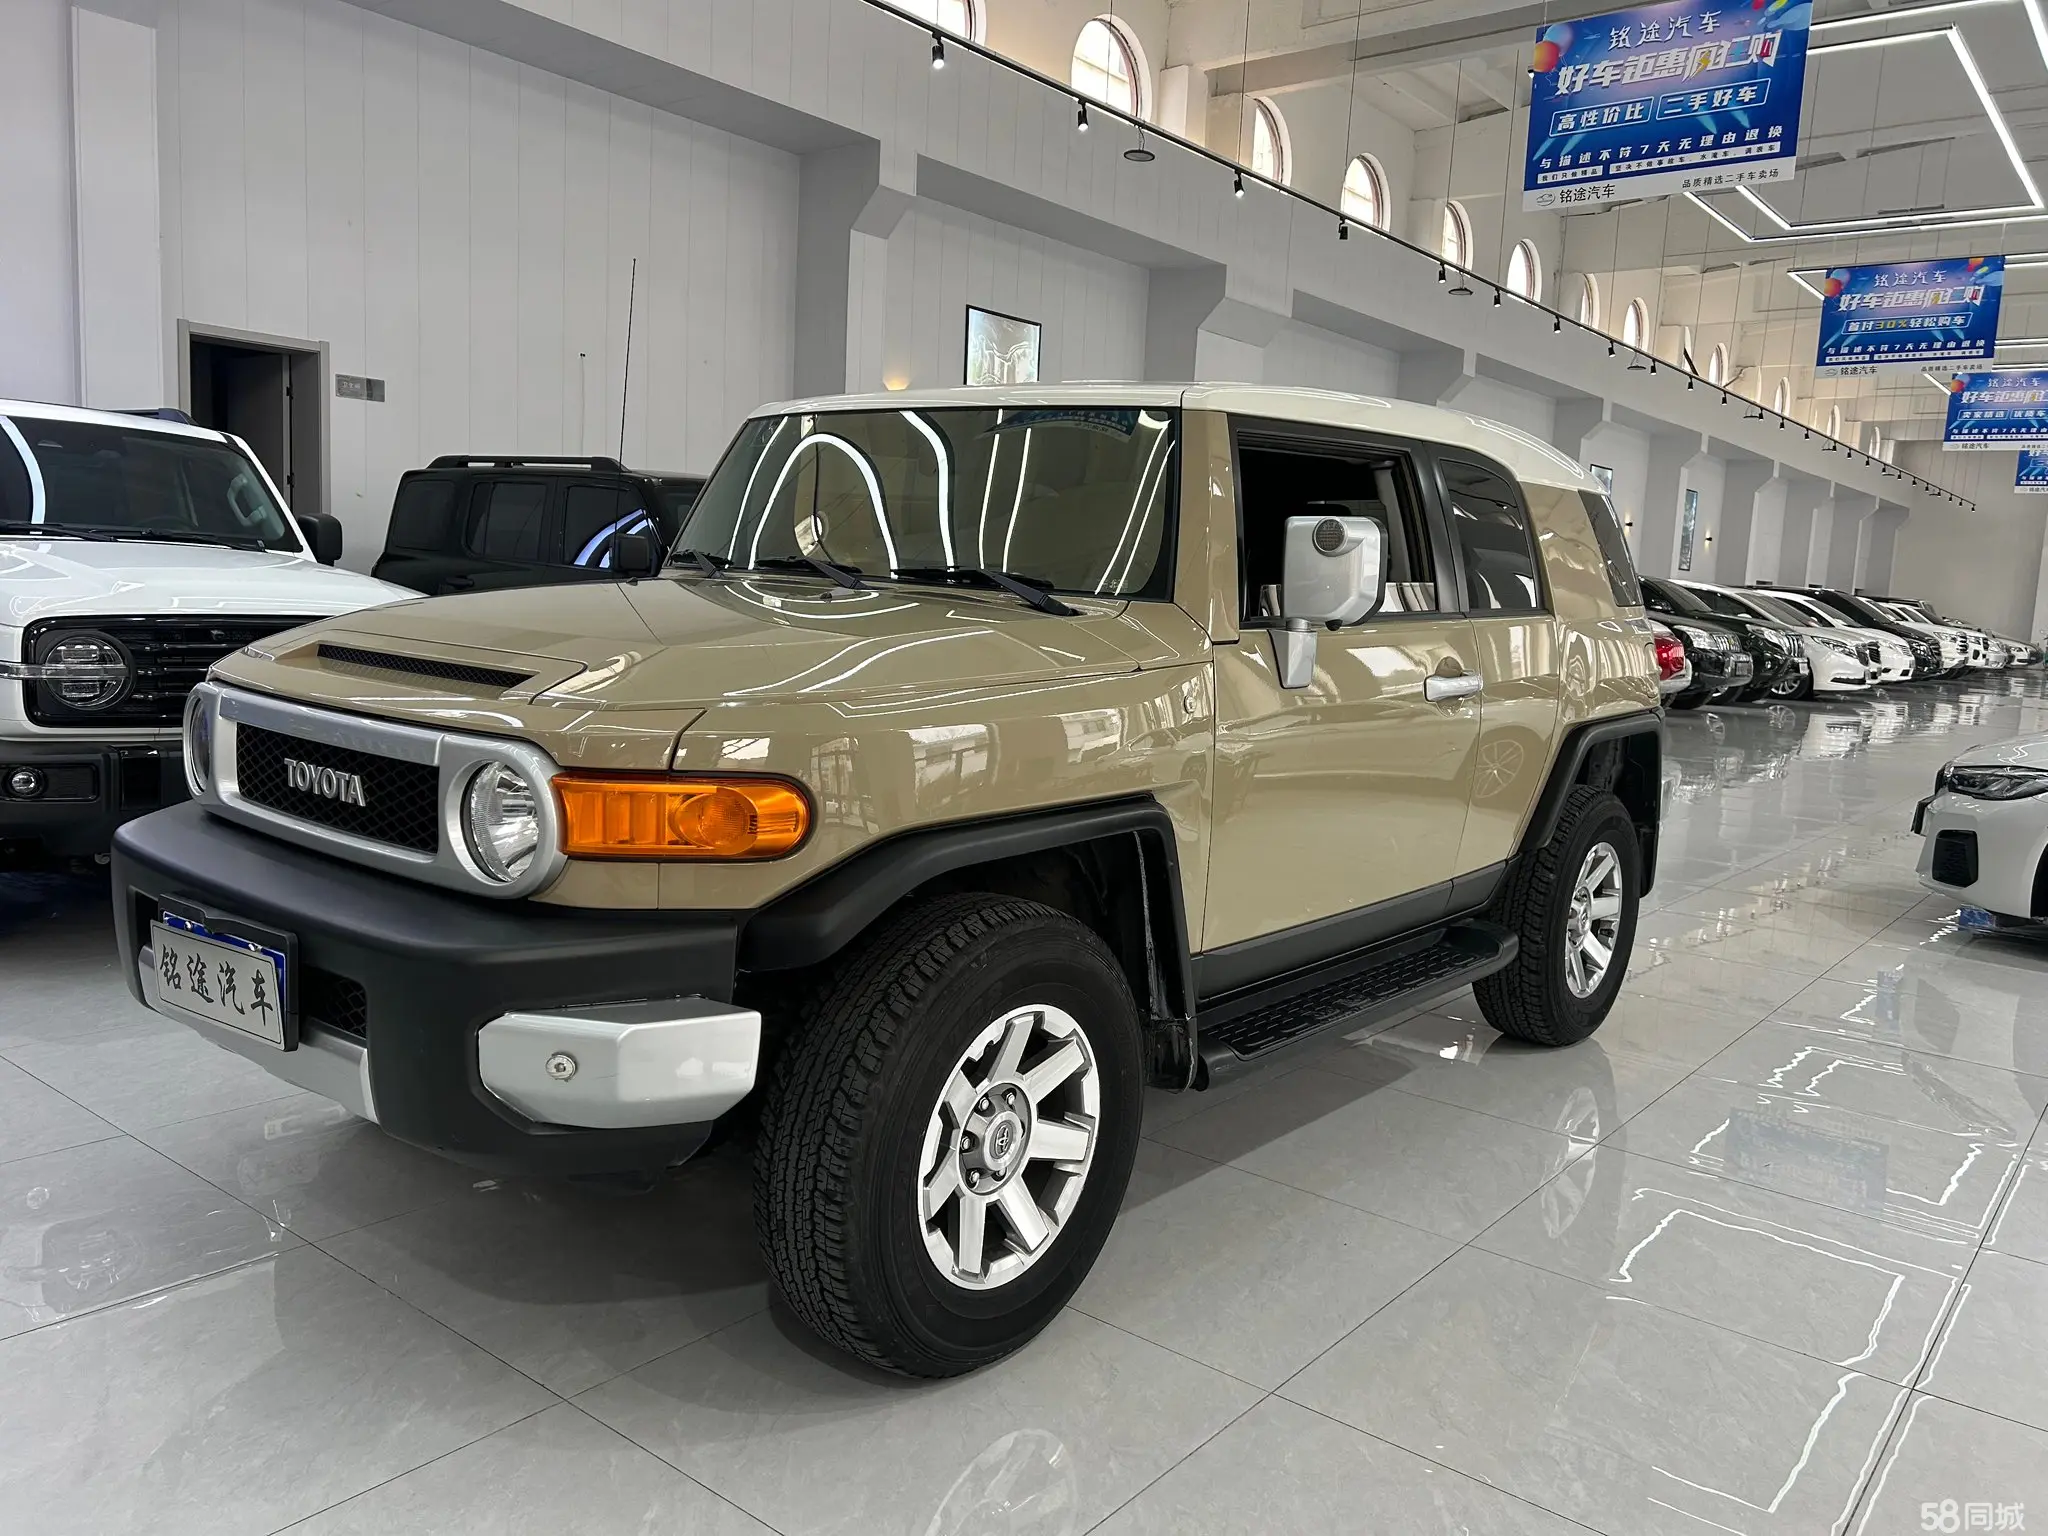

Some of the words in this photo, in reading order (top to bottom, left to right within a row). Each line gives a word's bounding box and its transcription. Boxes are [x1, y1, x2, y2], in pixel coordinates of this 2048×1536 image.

[1608, 10, 1722, 50] 铭途汽车
[1557, 101, 1645, 131] 高性价比
[1663, 86, 1759, 114] 二手好车
[1539, 125, 1784, 169] 与描述不符7天无理由退换
[1559, 183, 1615, 203] 铭途汽车
[1682, 168, 1780, 188] 品质精选二手车卖场
[1848, 315, 1966, 332] 首付30%轻松购车
[1840, 366, 1878, 376] 铭途汽车
[284, 757, 367, 807] TOYOTA
[160, 943, 274, 1026] 铭途汽车
